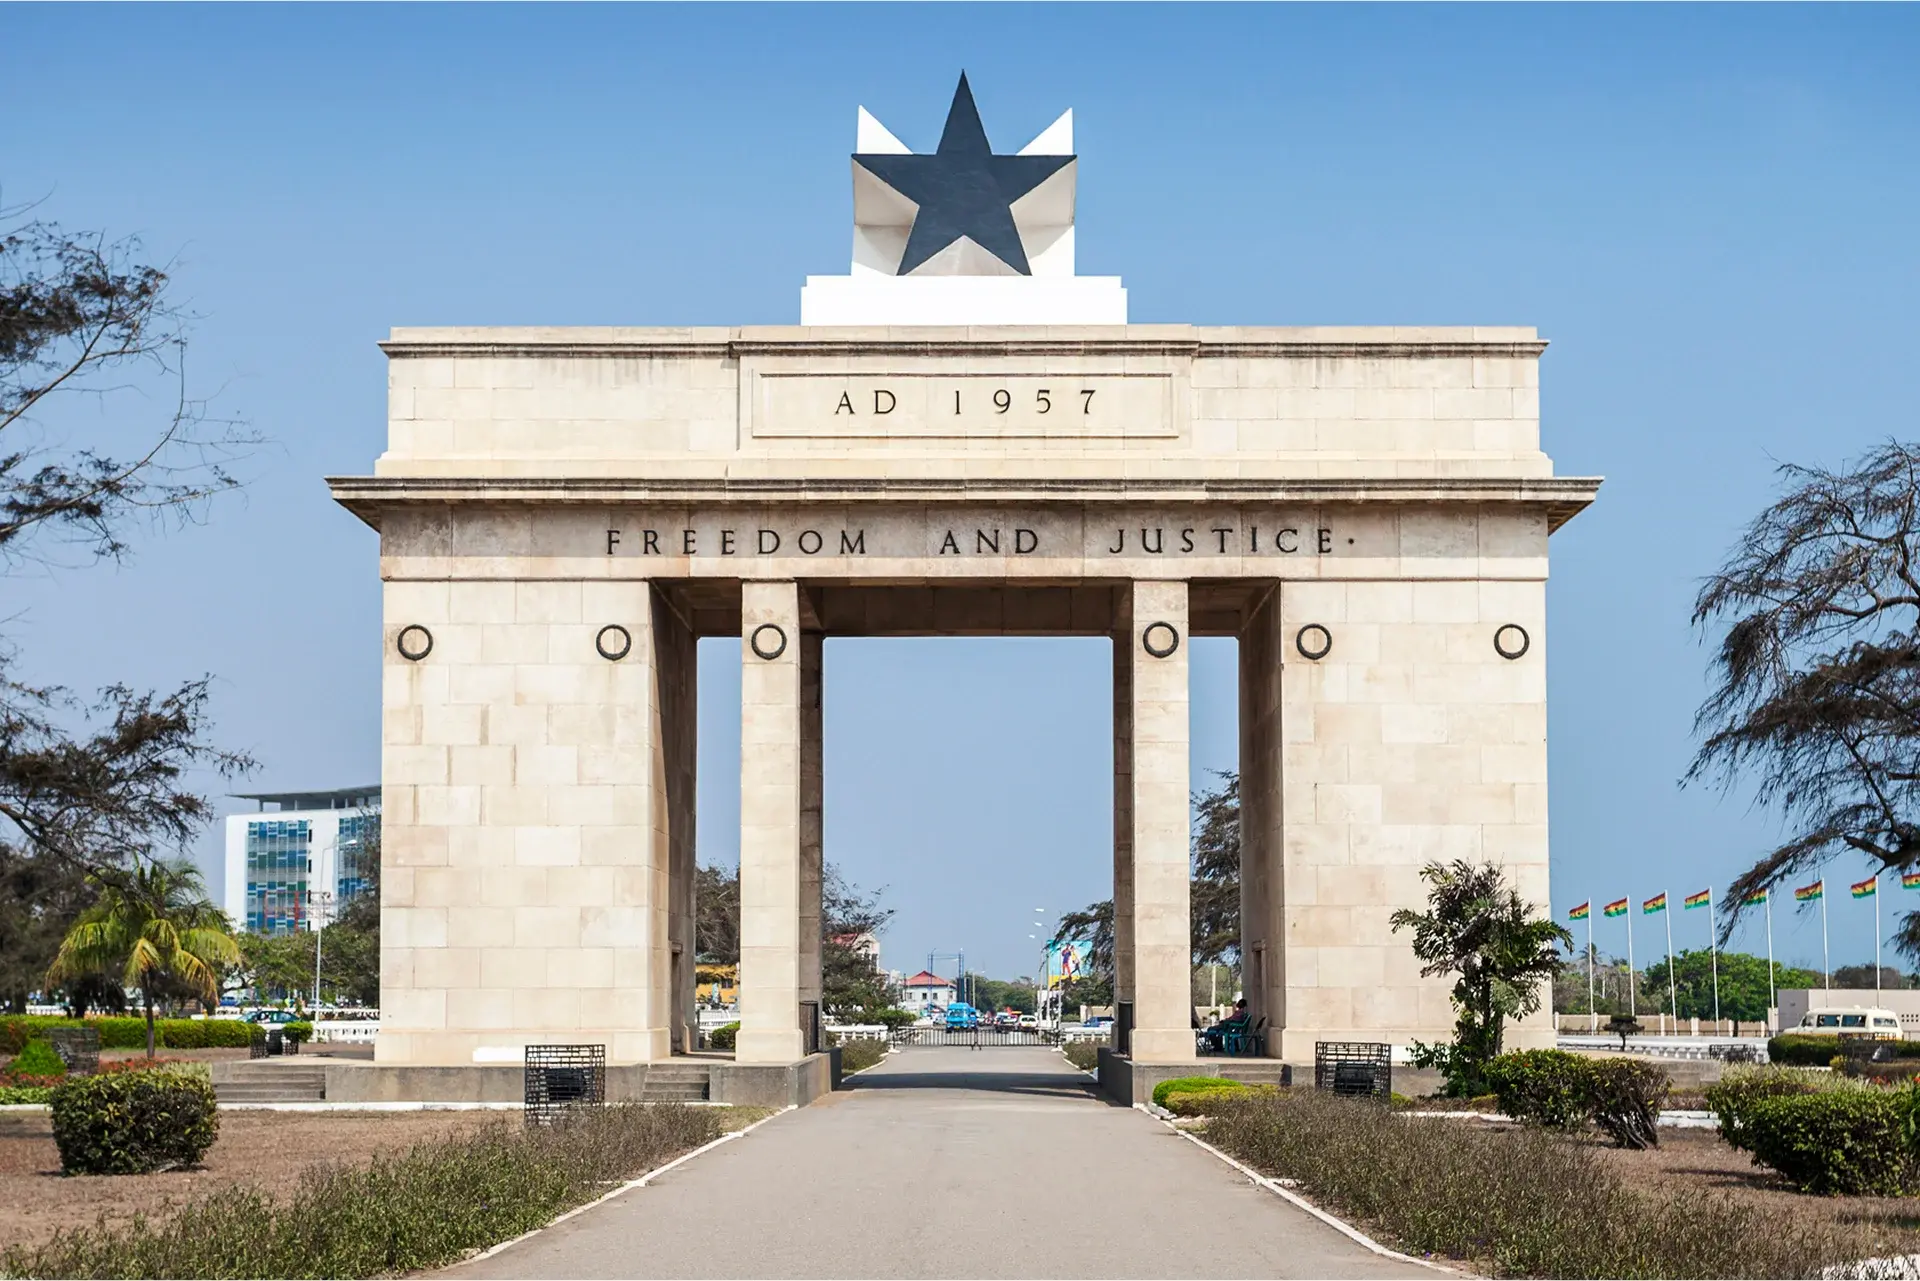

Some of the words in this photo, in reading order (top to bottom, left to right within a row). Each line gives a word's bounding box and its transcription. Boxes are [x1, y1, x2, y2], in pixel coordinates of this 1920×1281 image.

[834, 389, 897, 415] AD
[954, 388, 1098, 416] 1957
[605, 528, 867, 555] FREEDOM
[938, 528, 1040, 555] AND
